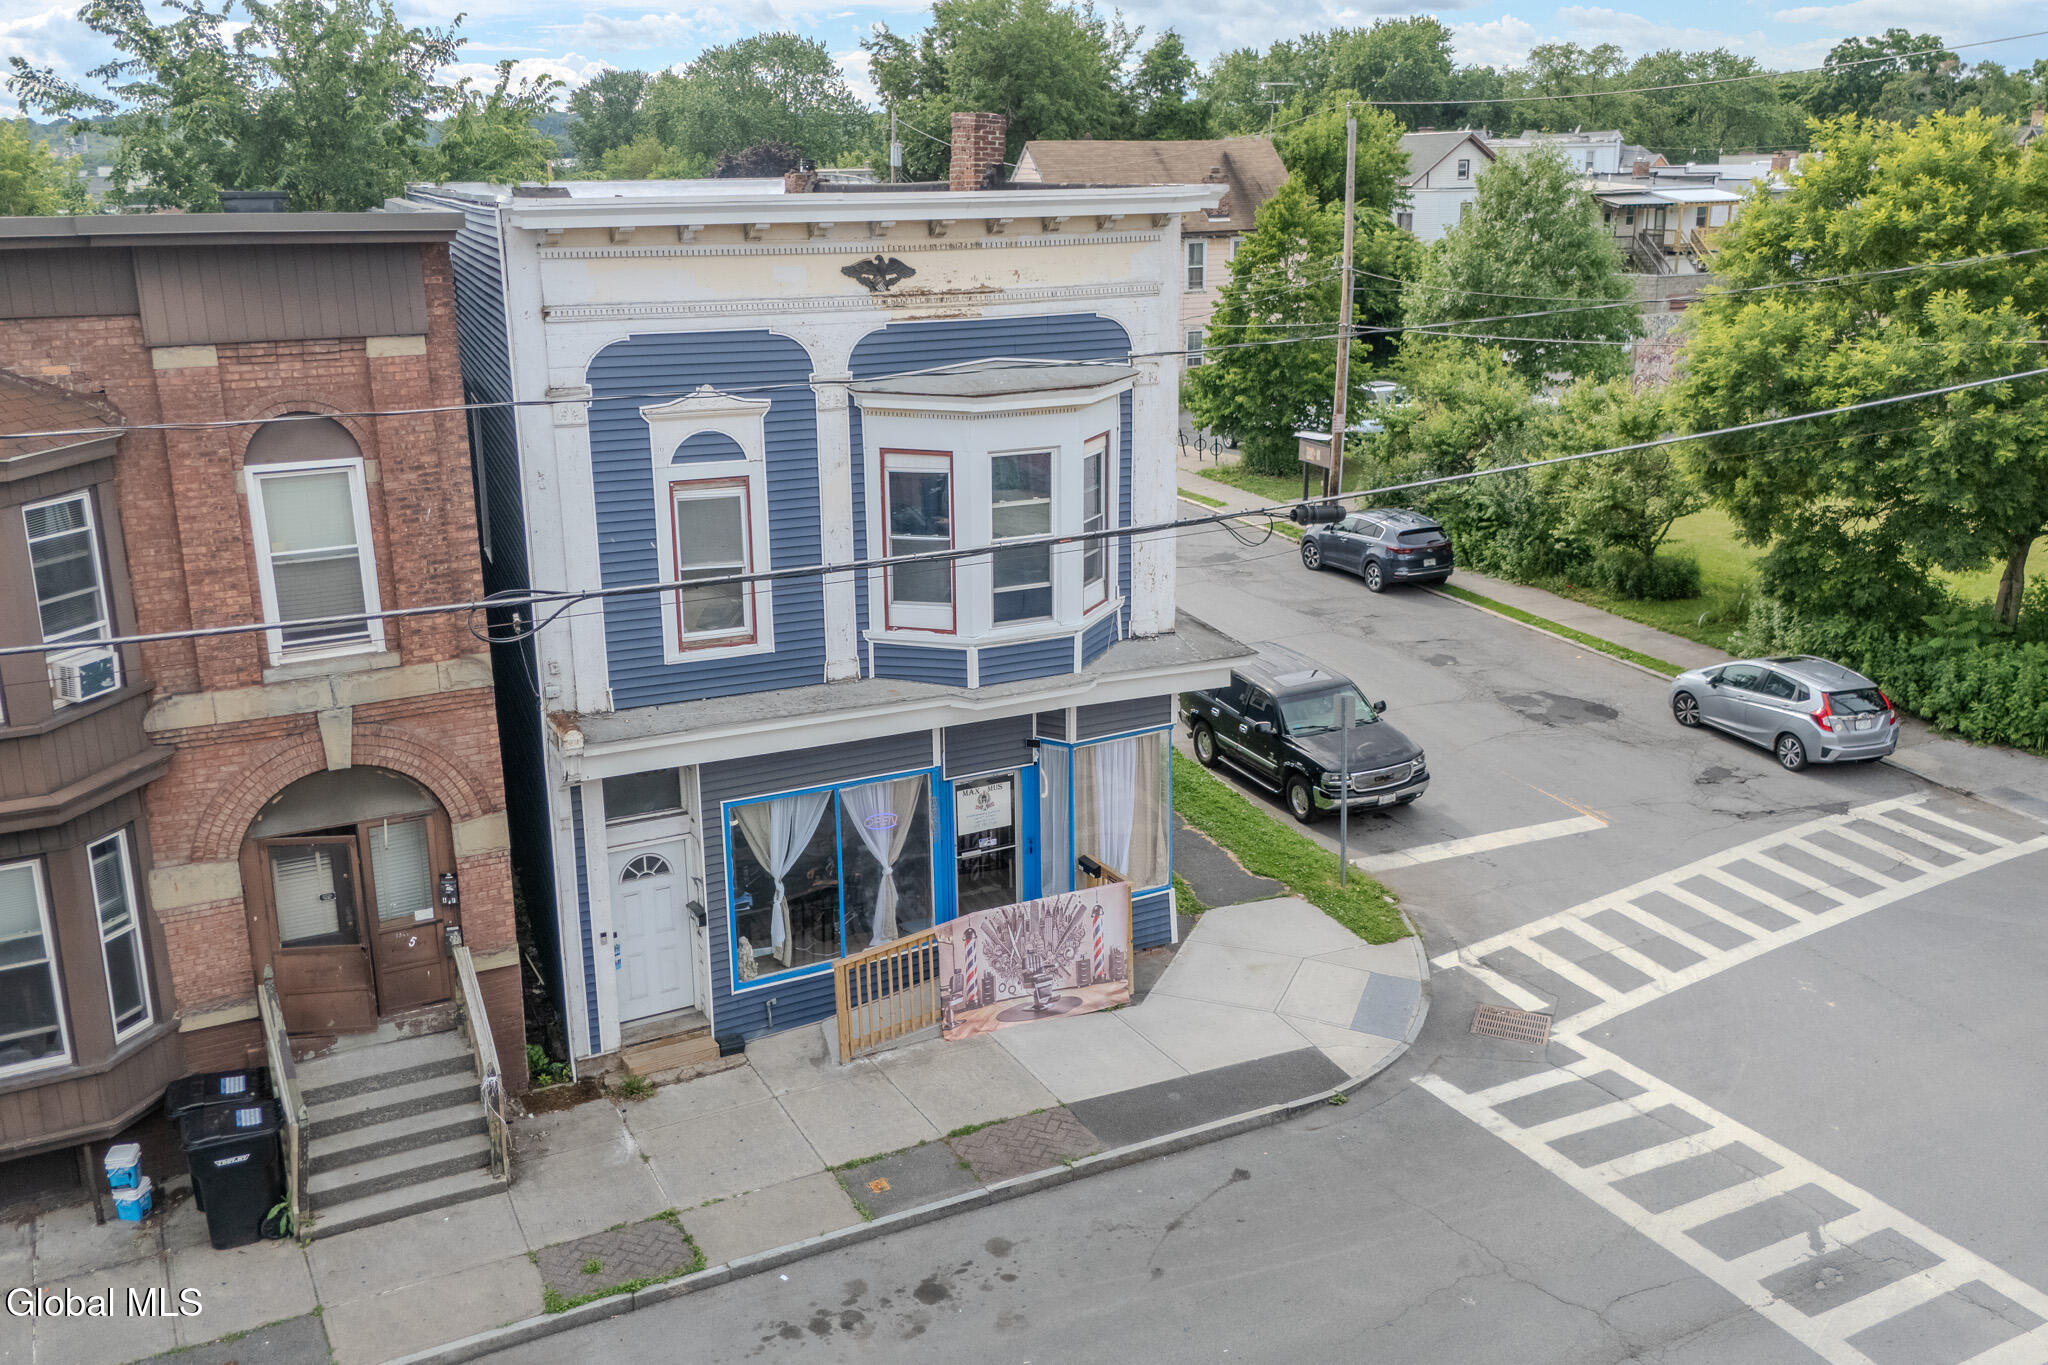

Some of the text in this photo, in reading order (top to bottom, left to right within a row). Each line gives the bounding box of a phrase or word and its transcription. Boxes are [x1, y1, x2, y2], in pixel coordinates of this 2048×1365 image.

[962, 784, 1003, 797] MAX MUS
[864, 815, 898, 828] OPEN
